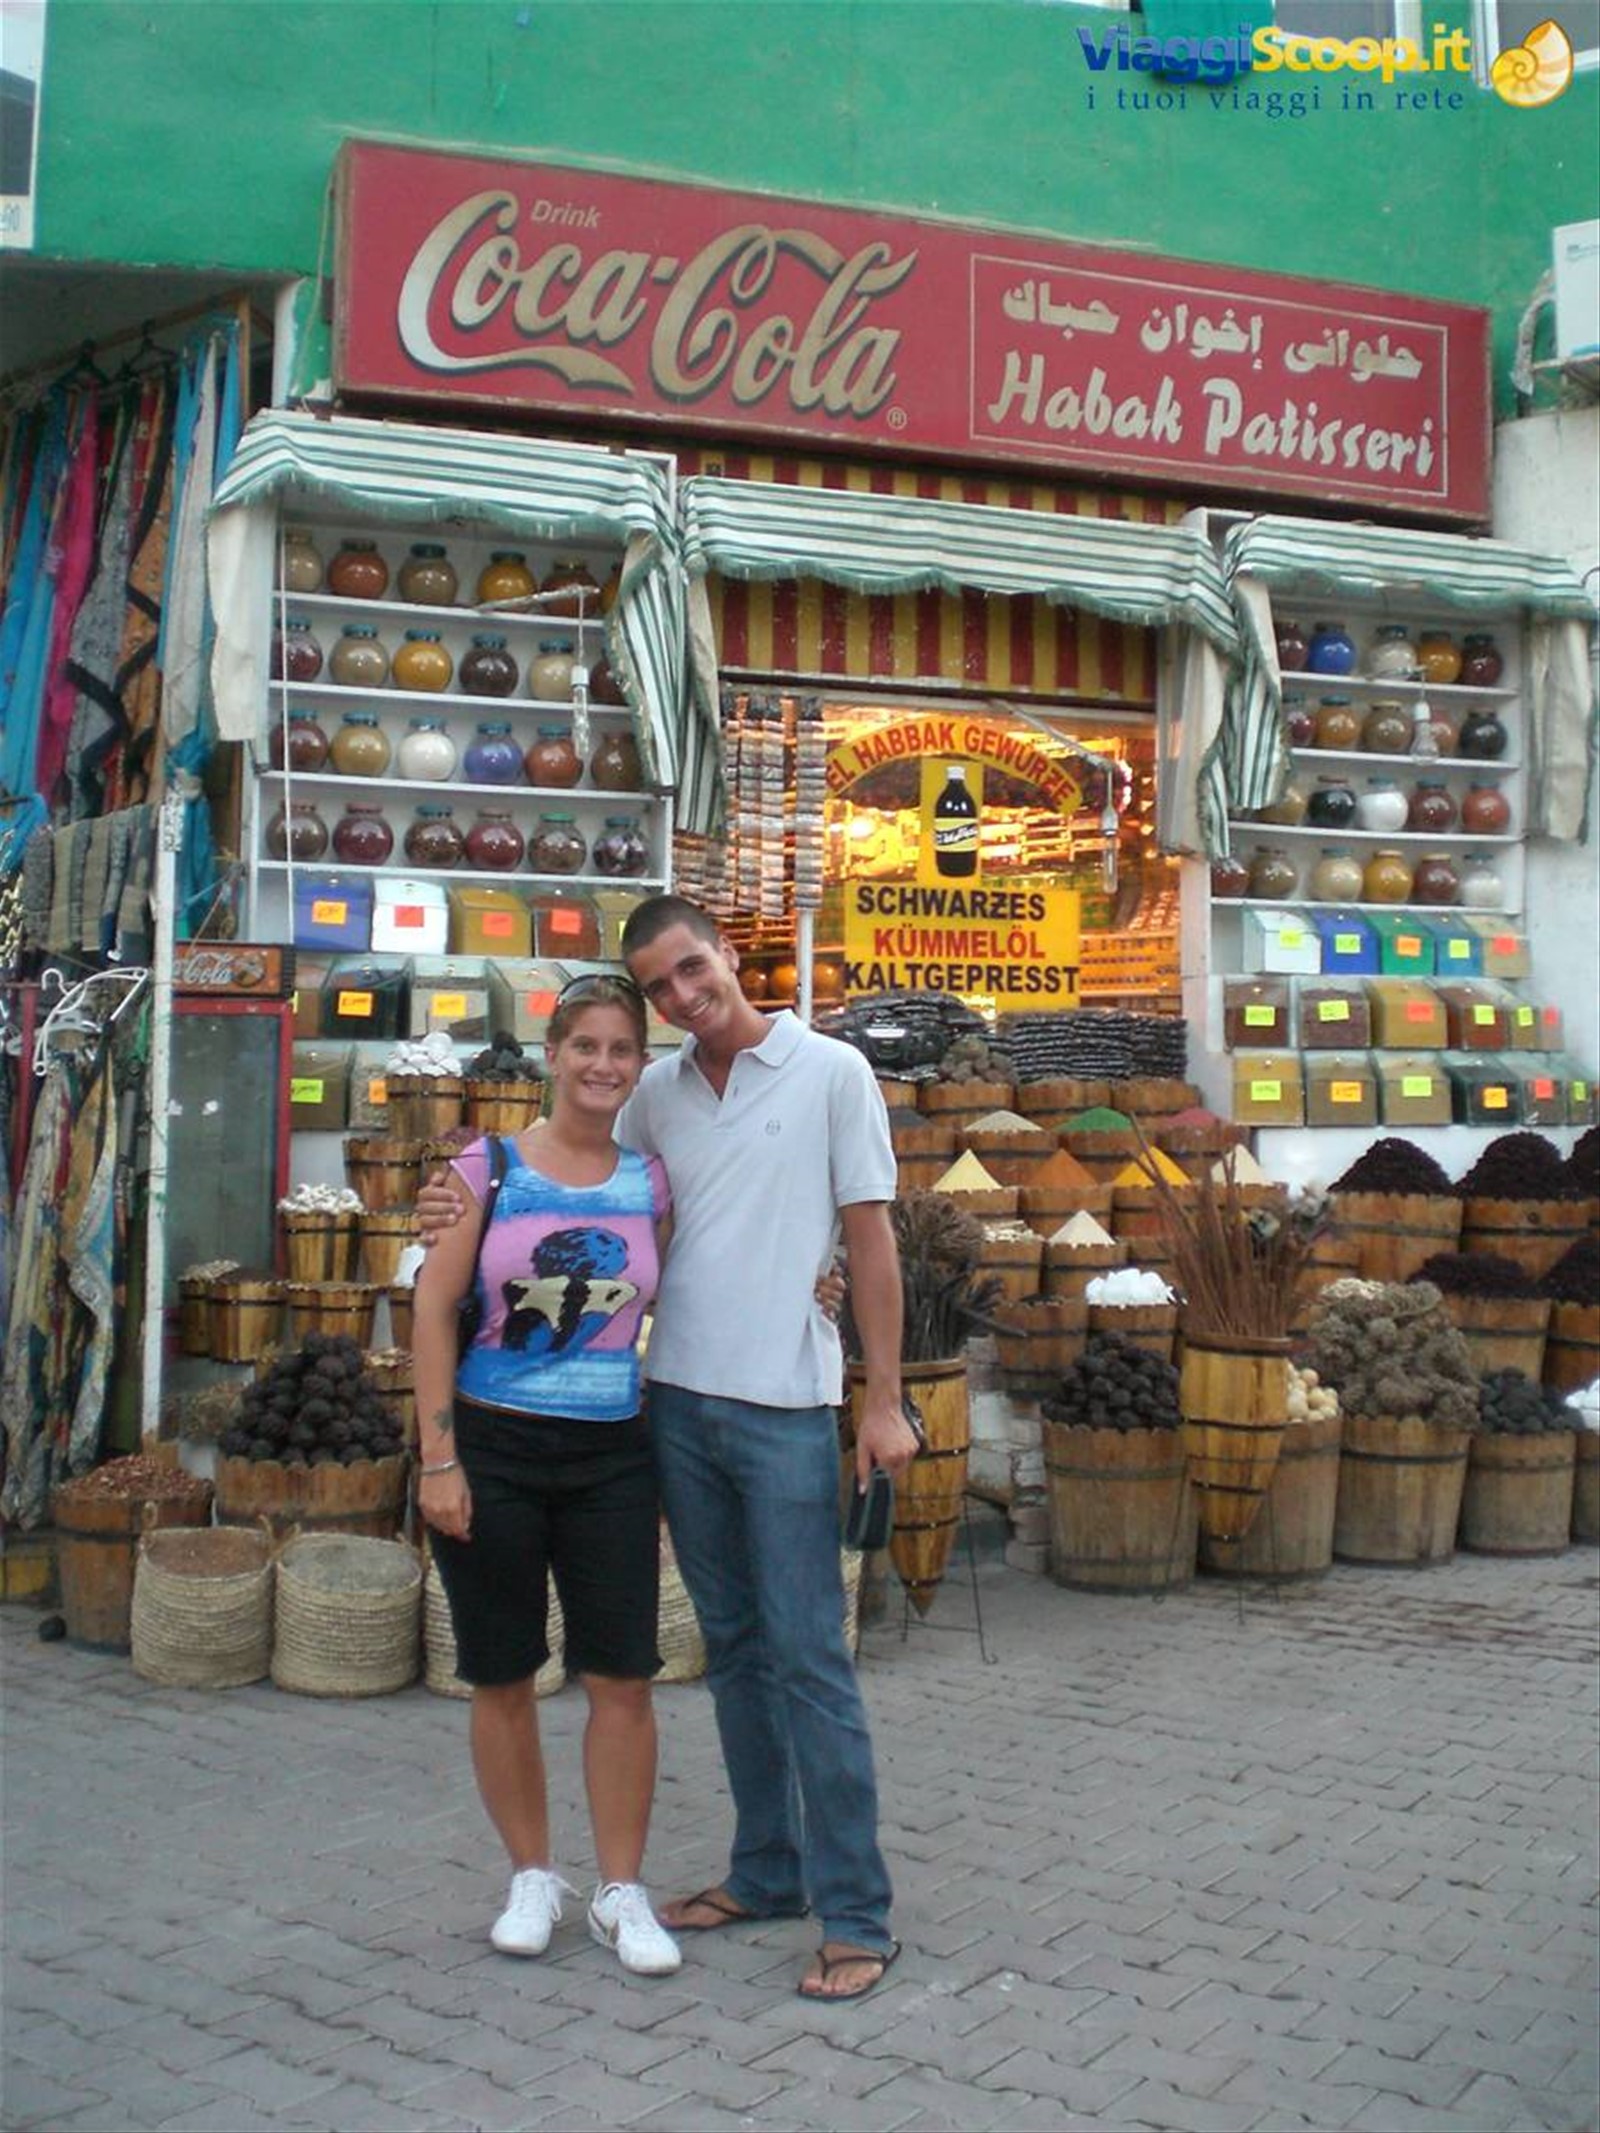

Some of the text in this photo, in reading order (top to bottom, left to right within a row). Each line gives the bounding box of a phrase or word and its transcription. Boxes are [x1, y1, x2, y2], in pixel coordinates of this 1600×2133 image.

[530, 199, 602, 230] Drink
[397, 189, 919, 419] Coca-Cola
[987, 349, 1436, 479] Habak Patisseri
[852, 721, 957, 771] HABBAK
[856, 884, 1047, 922] SCHWARZES
[873, 922, 1047, 960] KÜMMELÖL
[844, 961, 1081, 994] KALTGEPRESST
